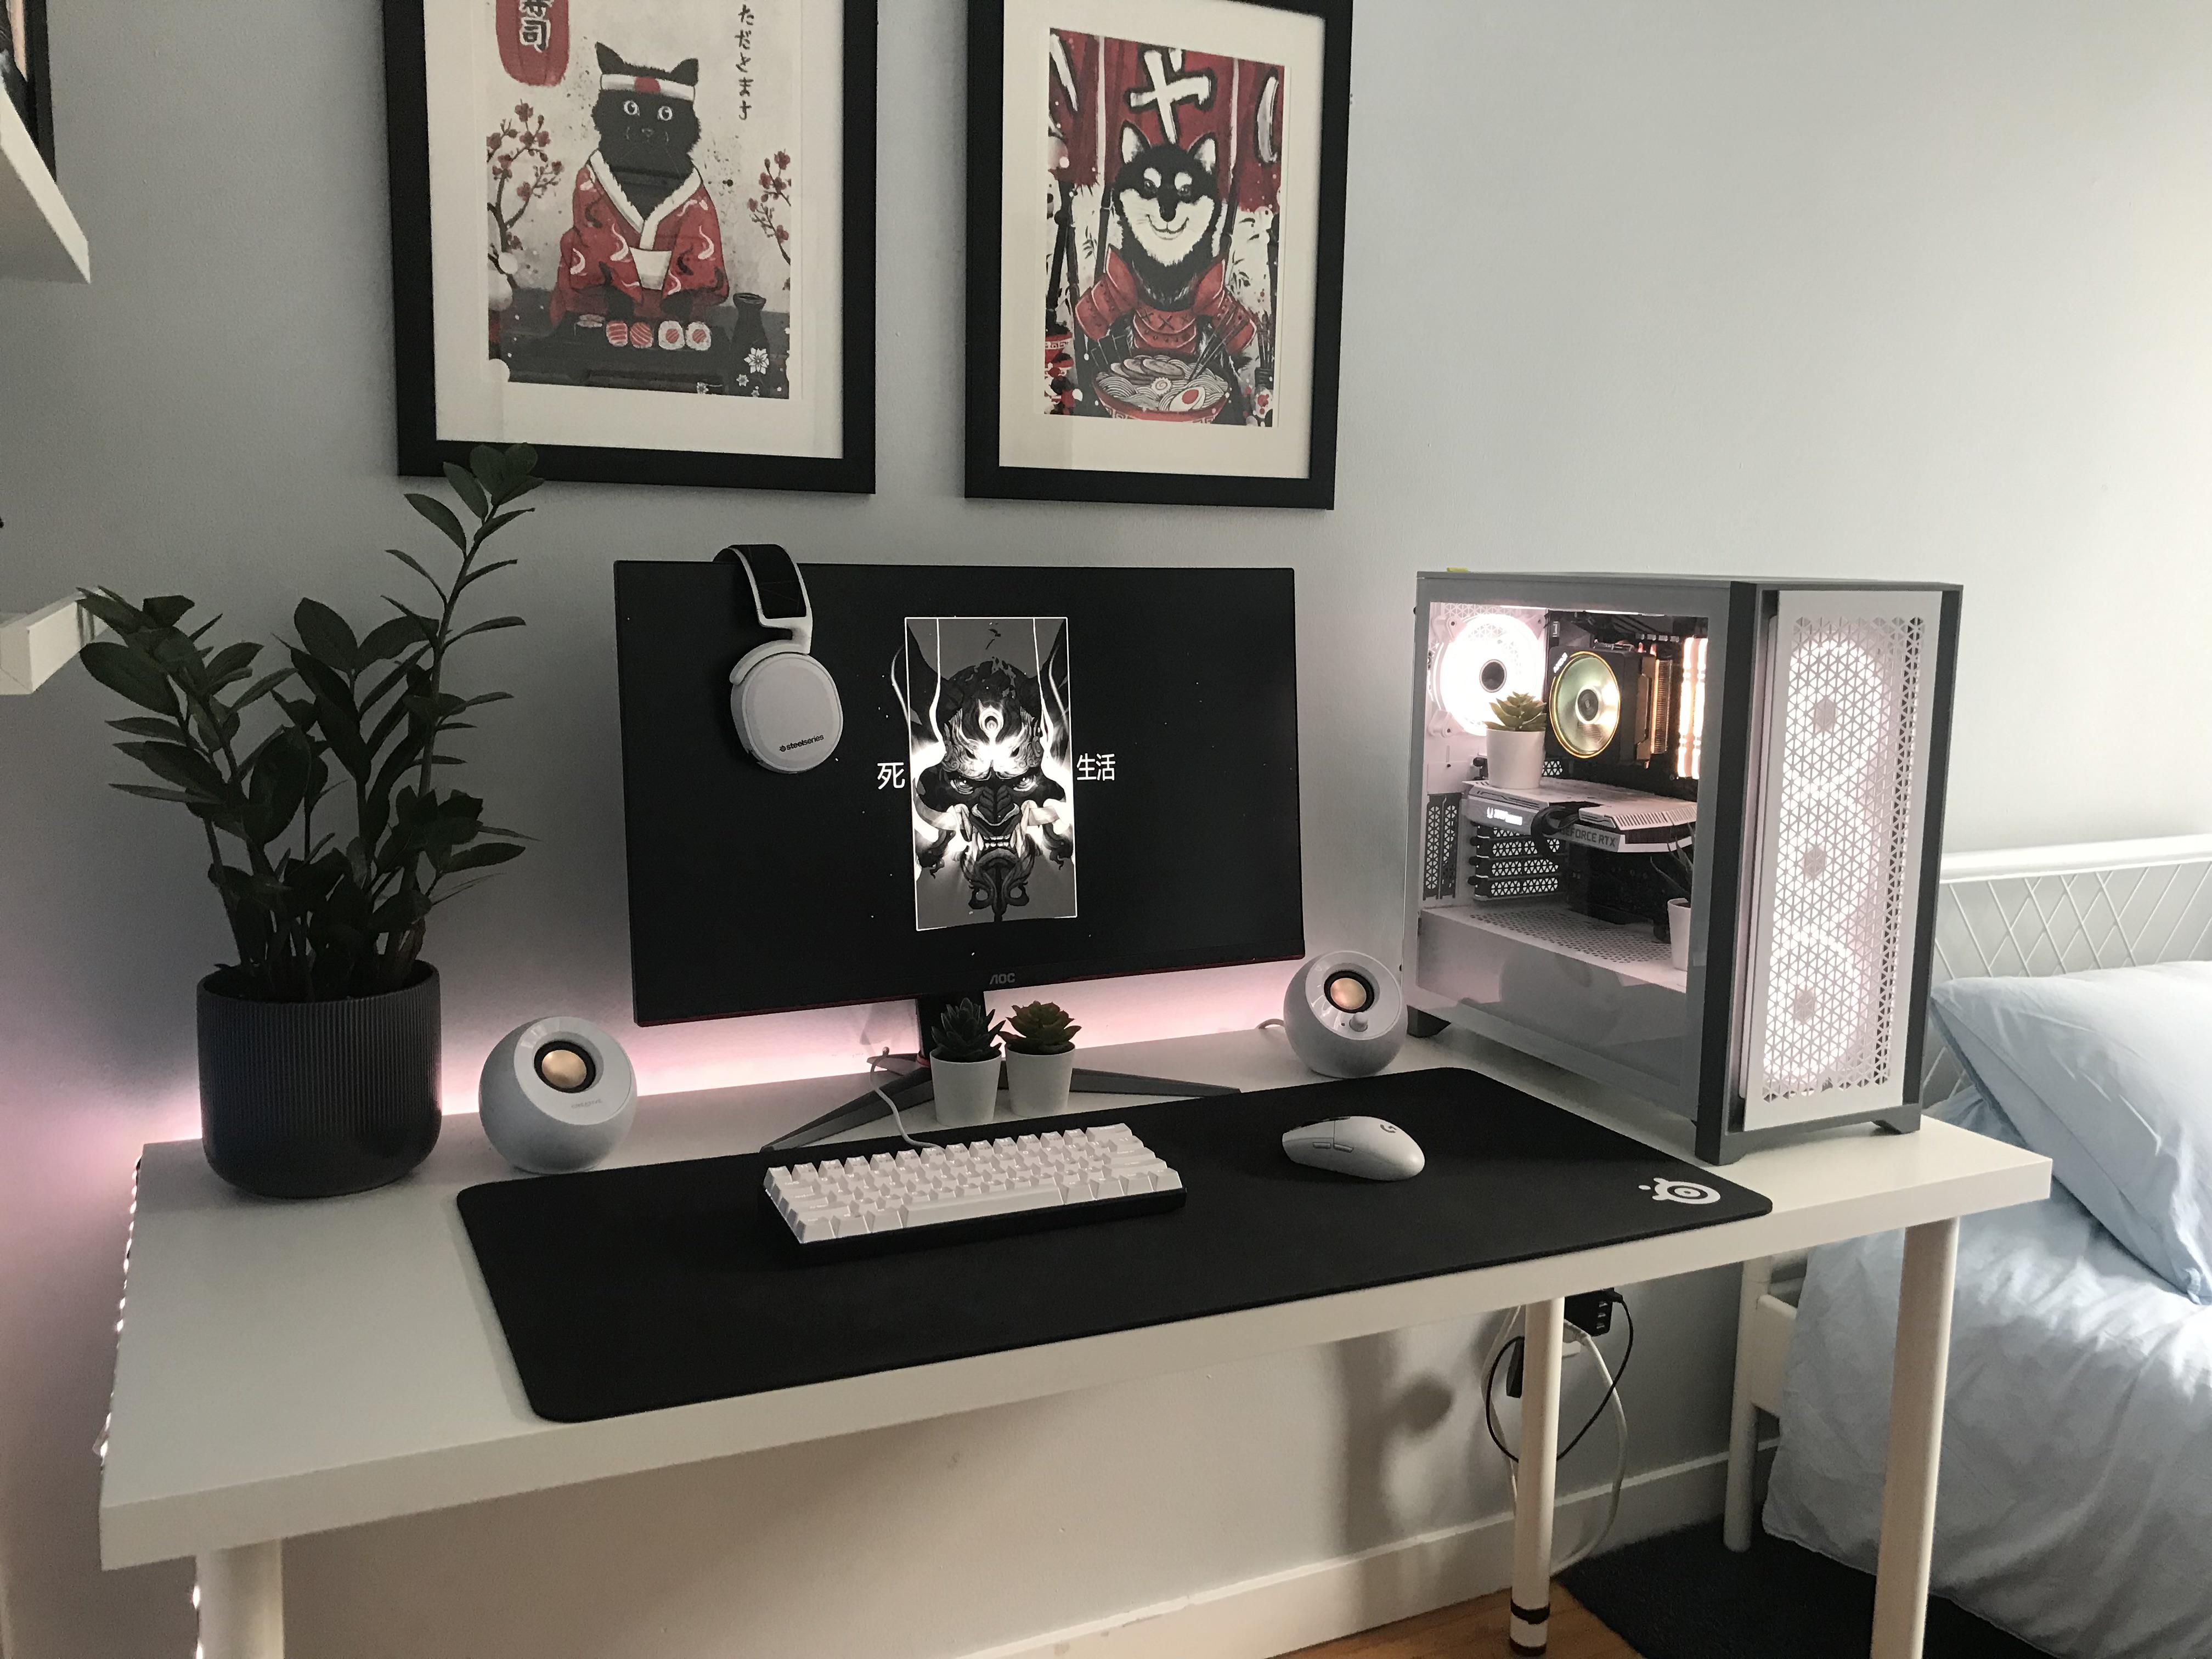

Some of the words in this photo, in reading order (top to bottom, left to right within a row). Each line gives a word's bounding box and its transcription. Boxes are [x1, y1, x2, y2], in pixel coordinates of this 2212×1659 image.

[787, 735, 824, 750] steelseries
[1077, 753, 1115, 781] 生活
[877, 763, 905, 789] 死
[1599, 834, 1616, 847] RTX
[990, 973, 1015, 985] AOC
